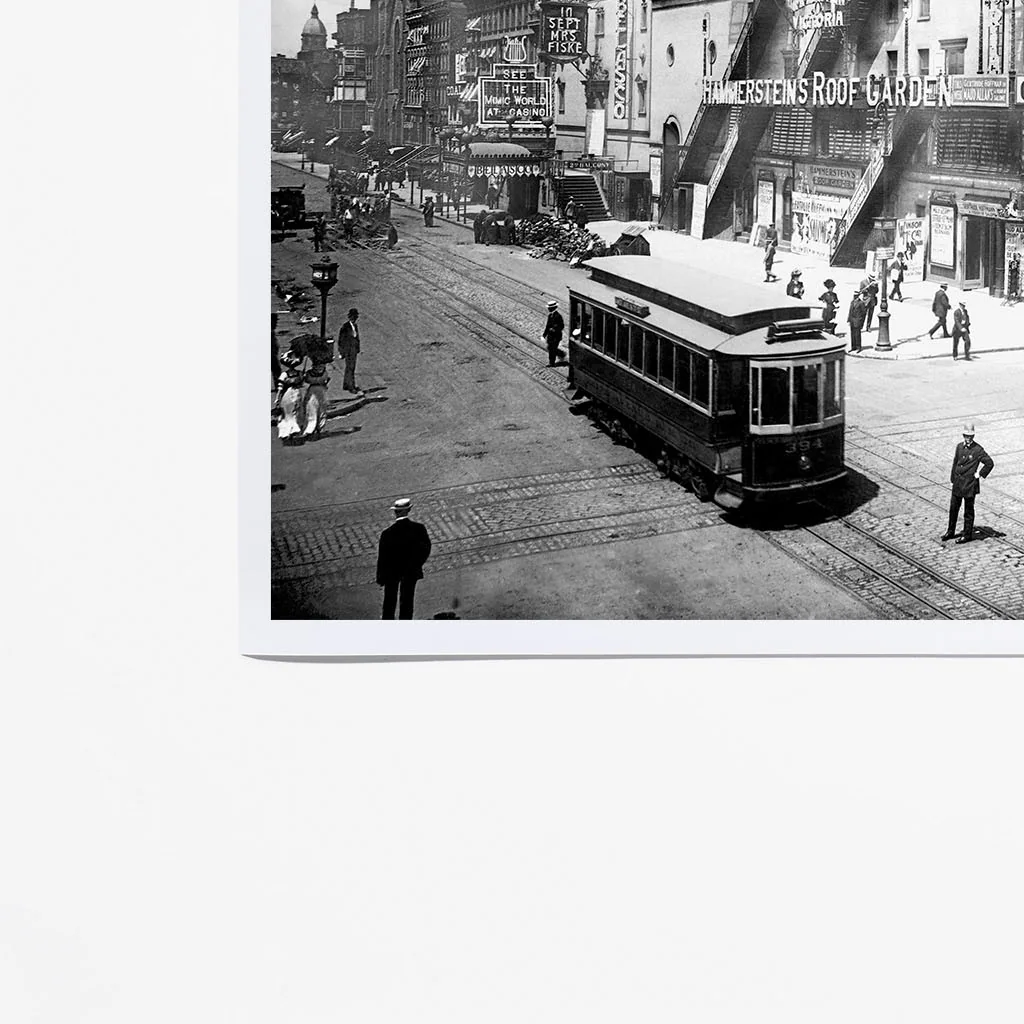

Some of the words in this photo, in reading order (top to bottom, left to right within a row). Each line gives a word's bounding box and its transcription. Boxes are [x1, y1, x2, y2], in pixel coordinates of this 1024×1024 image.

[548, 17, 581, 30] SEPT
[550, 30, 577, 42] MRS
[547, 42, 583, 54] FISKE
[503, 69, 527, 79] SEE
[504, 84, 527, 94] THE
[813, 71, 861, 107] ROOF
[866, 74, 952, 108] GARDEN
[514, 95, 546, 106] WORLD
[509, 107, 546, 116] CASINO
